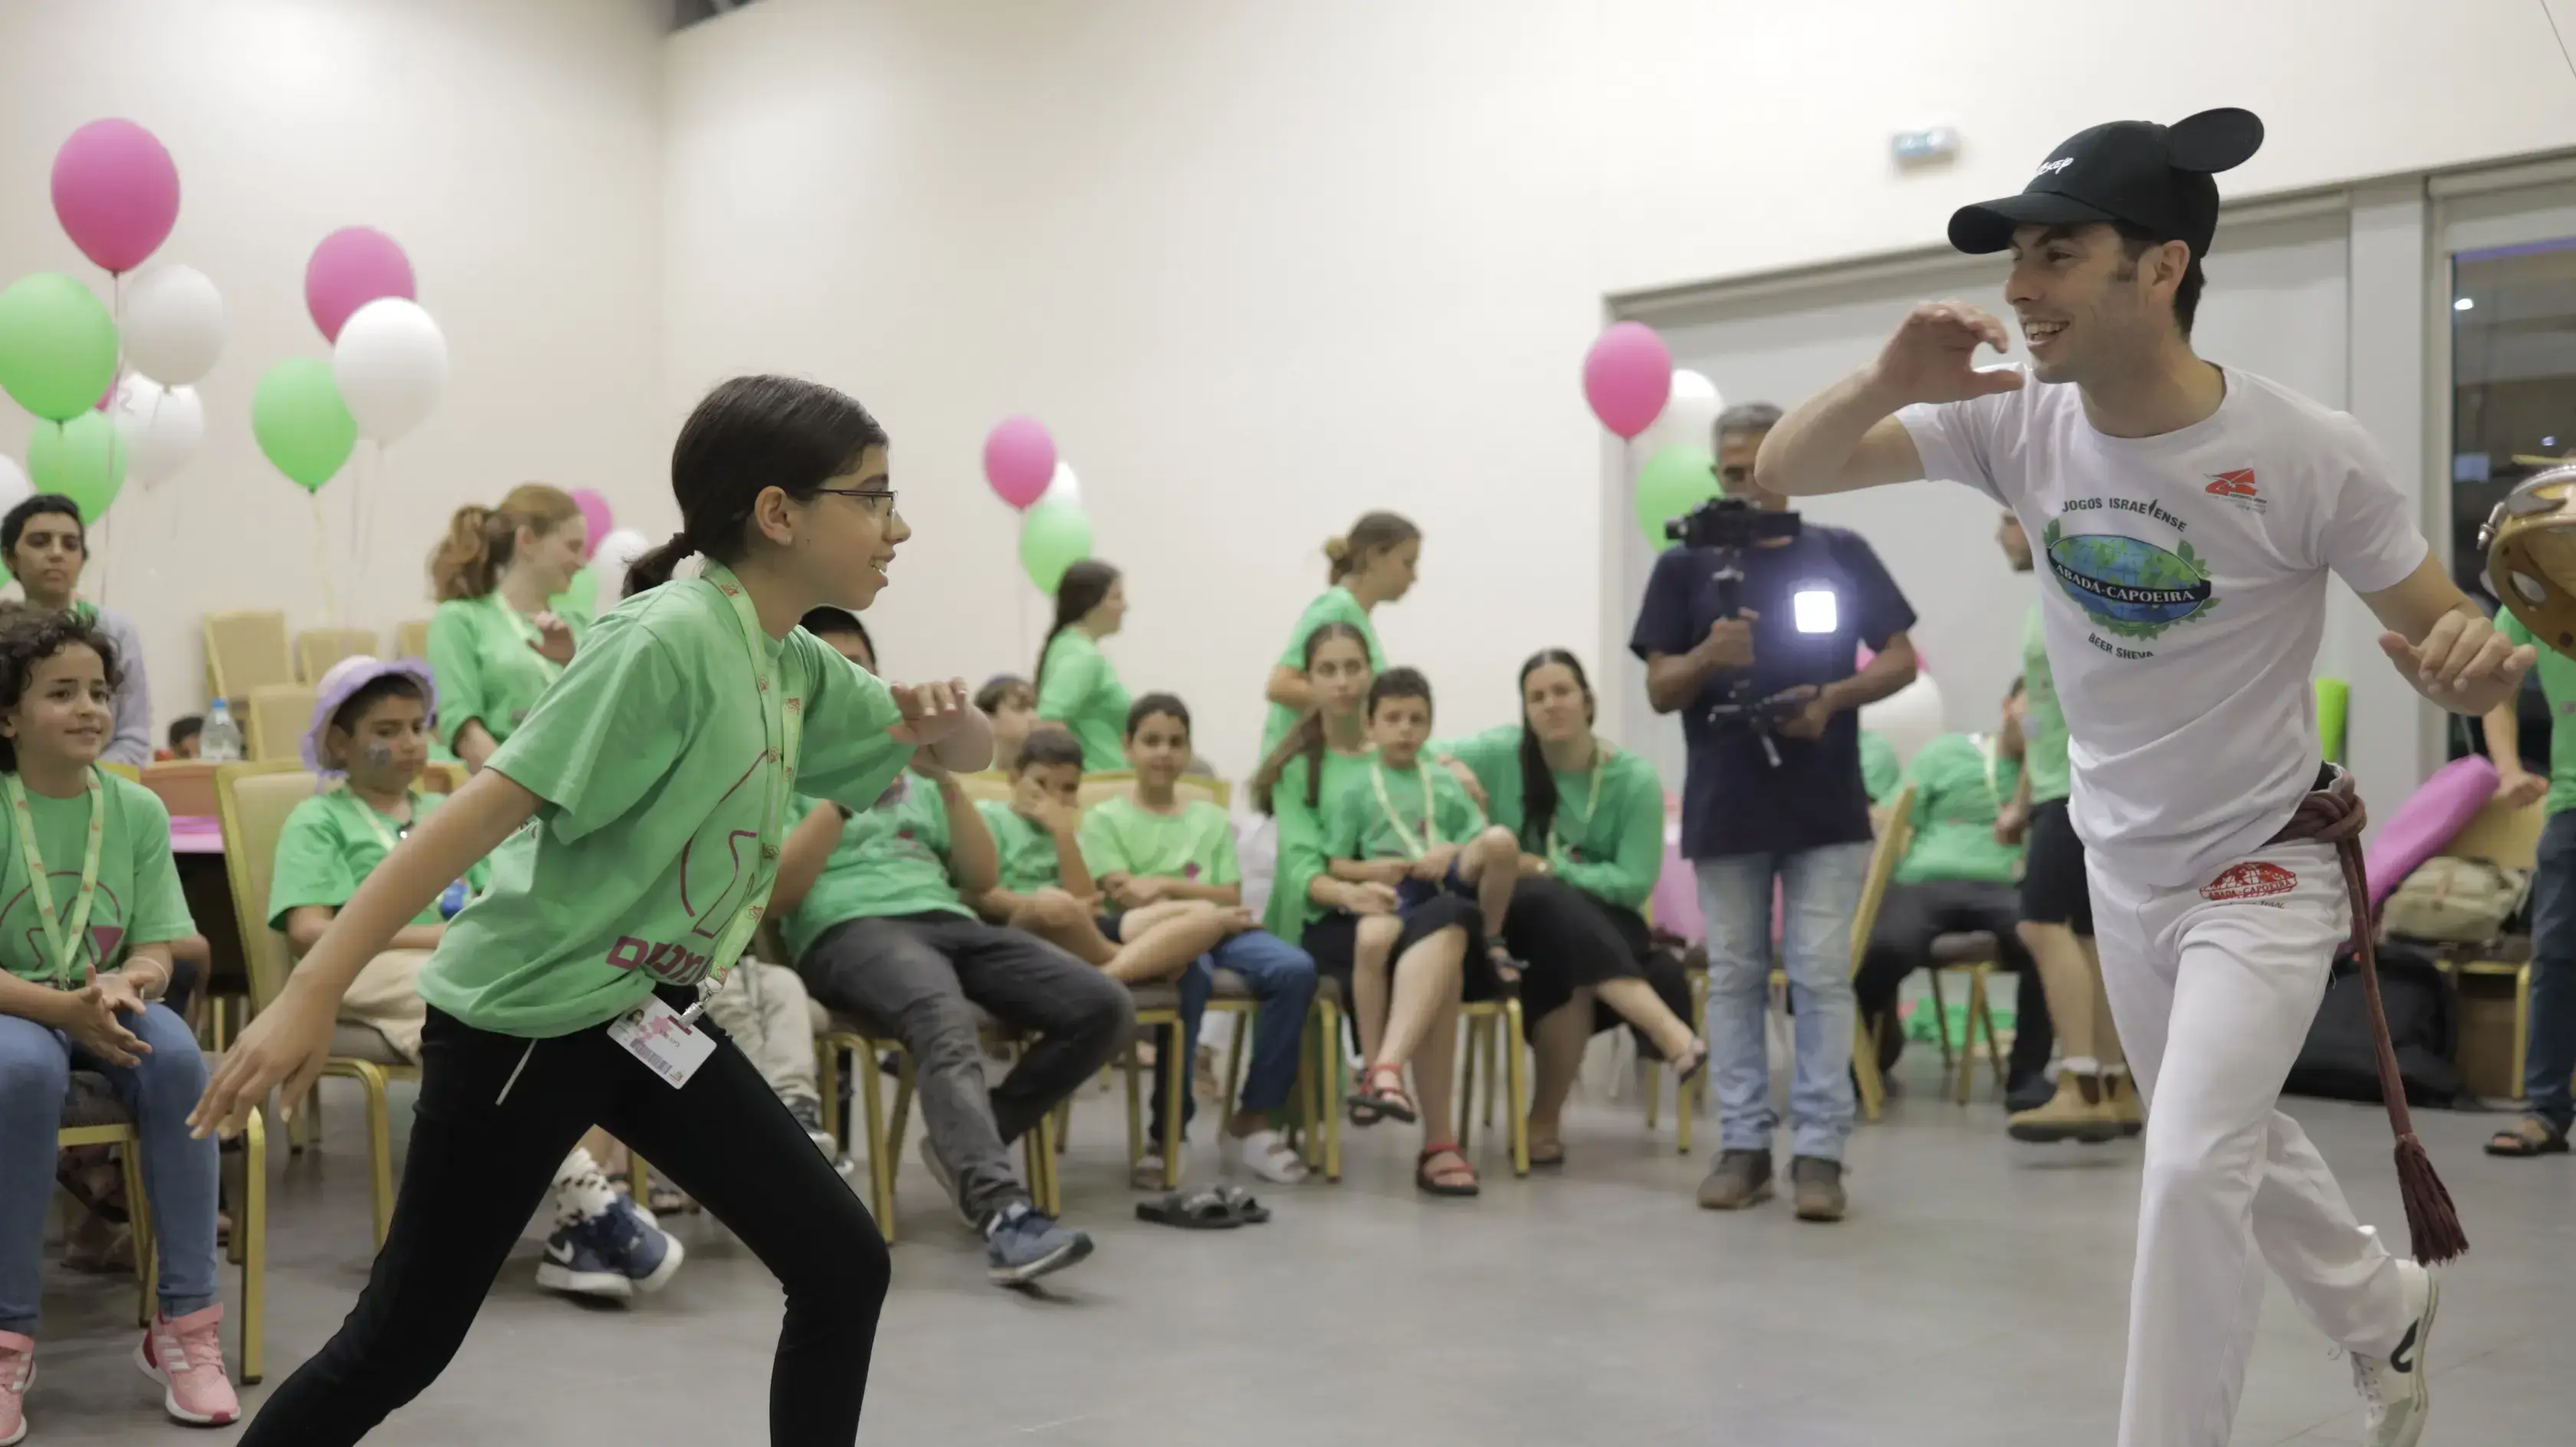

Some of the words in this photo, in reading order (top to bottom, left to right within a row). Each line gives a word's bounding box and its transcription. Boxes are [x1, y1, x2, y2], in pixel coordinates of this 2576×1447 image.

[2062, 497, 2103, 513] JOGOS
[2055, 564, 2195, 603] ABADÁ-CAPOEIRA
[2088, 632, 2114, 654] BEER
[2116, 647, 2155, 660] SHEVA
